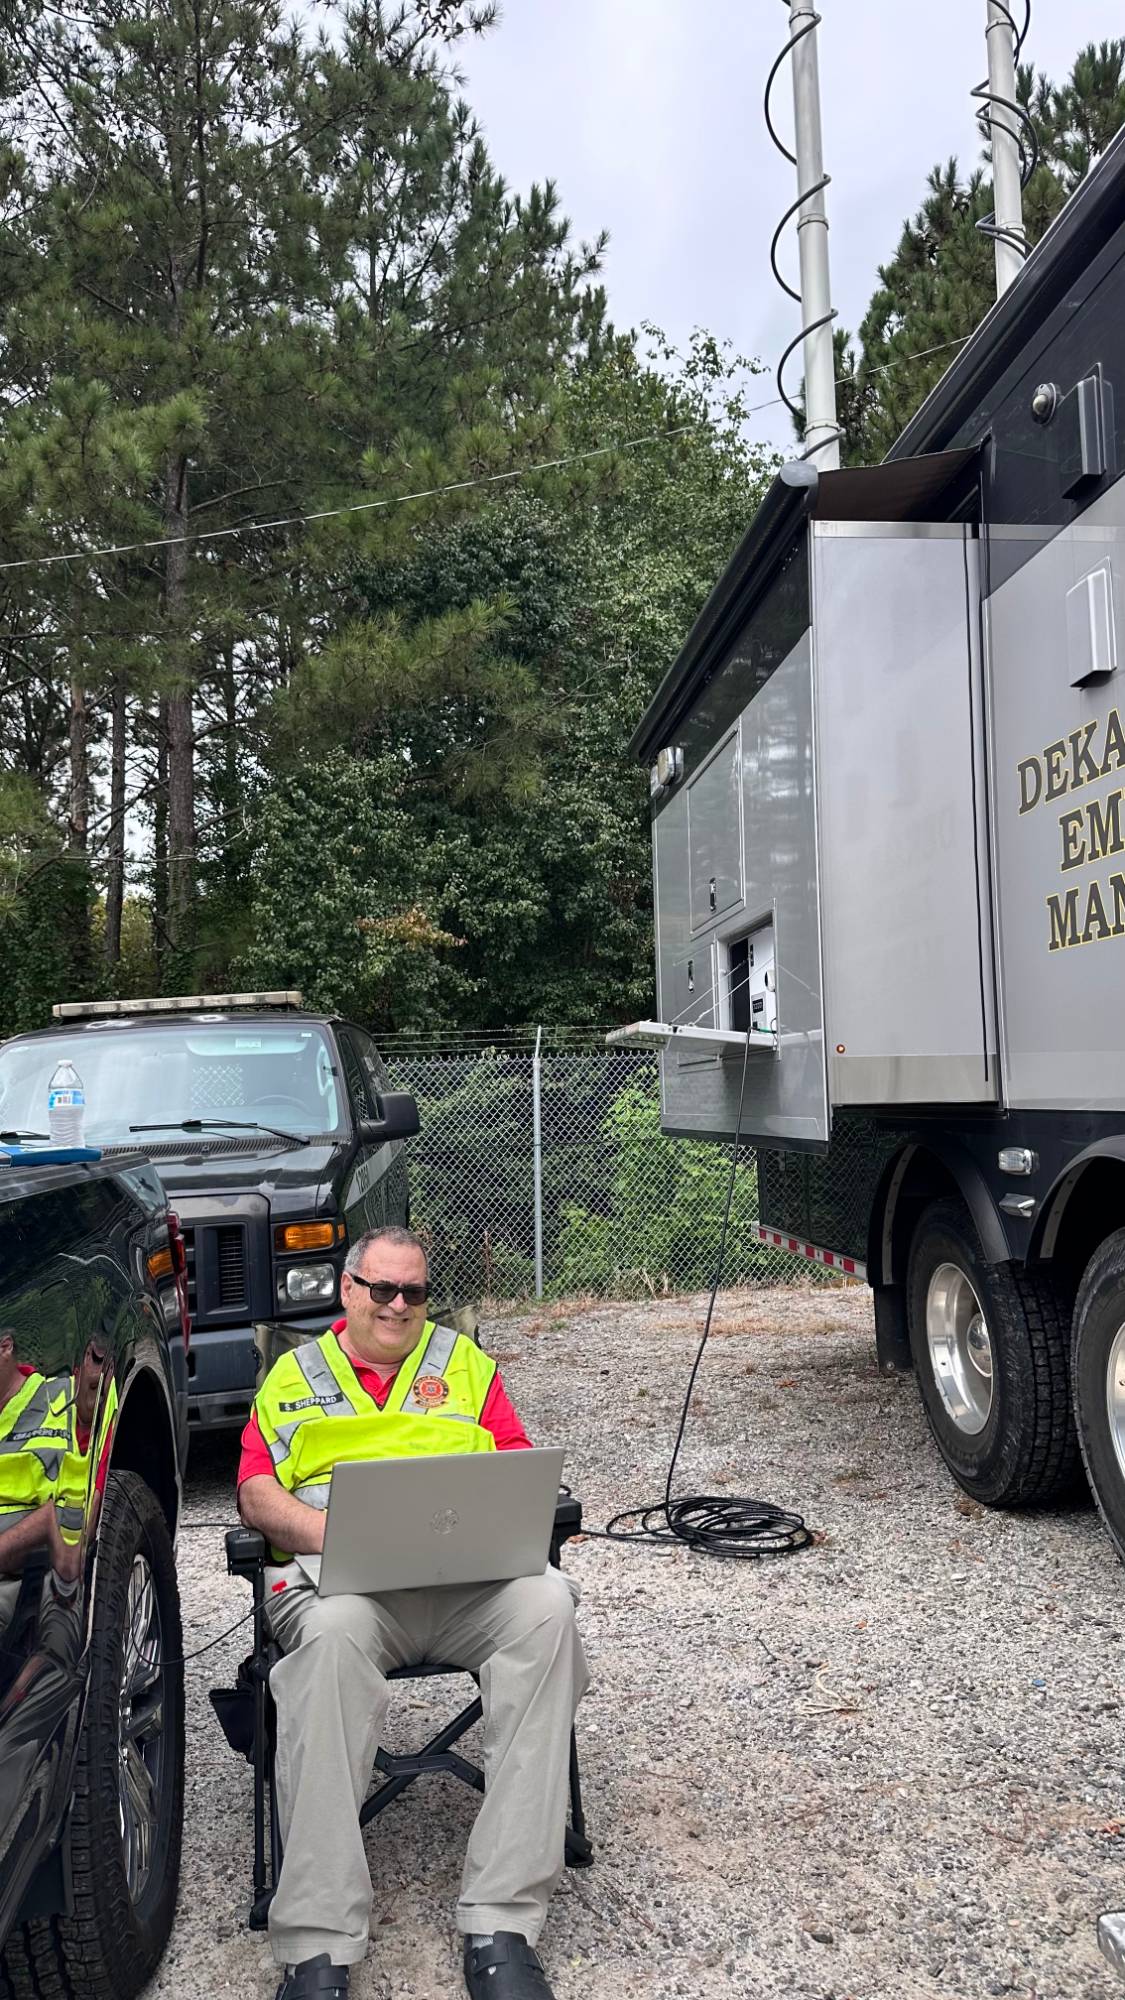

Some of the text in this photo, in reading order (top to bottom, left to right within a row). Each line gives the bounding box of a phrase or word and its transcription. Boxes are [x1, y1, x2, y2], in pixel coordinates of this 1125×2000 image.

[1017, 708, 1125, 816] DEKA
[1059, 788, 1125, 873] EM
[1046, 872, 1125, 952] MAN
[295, 1396, 337, 1409] SHEPPARD
